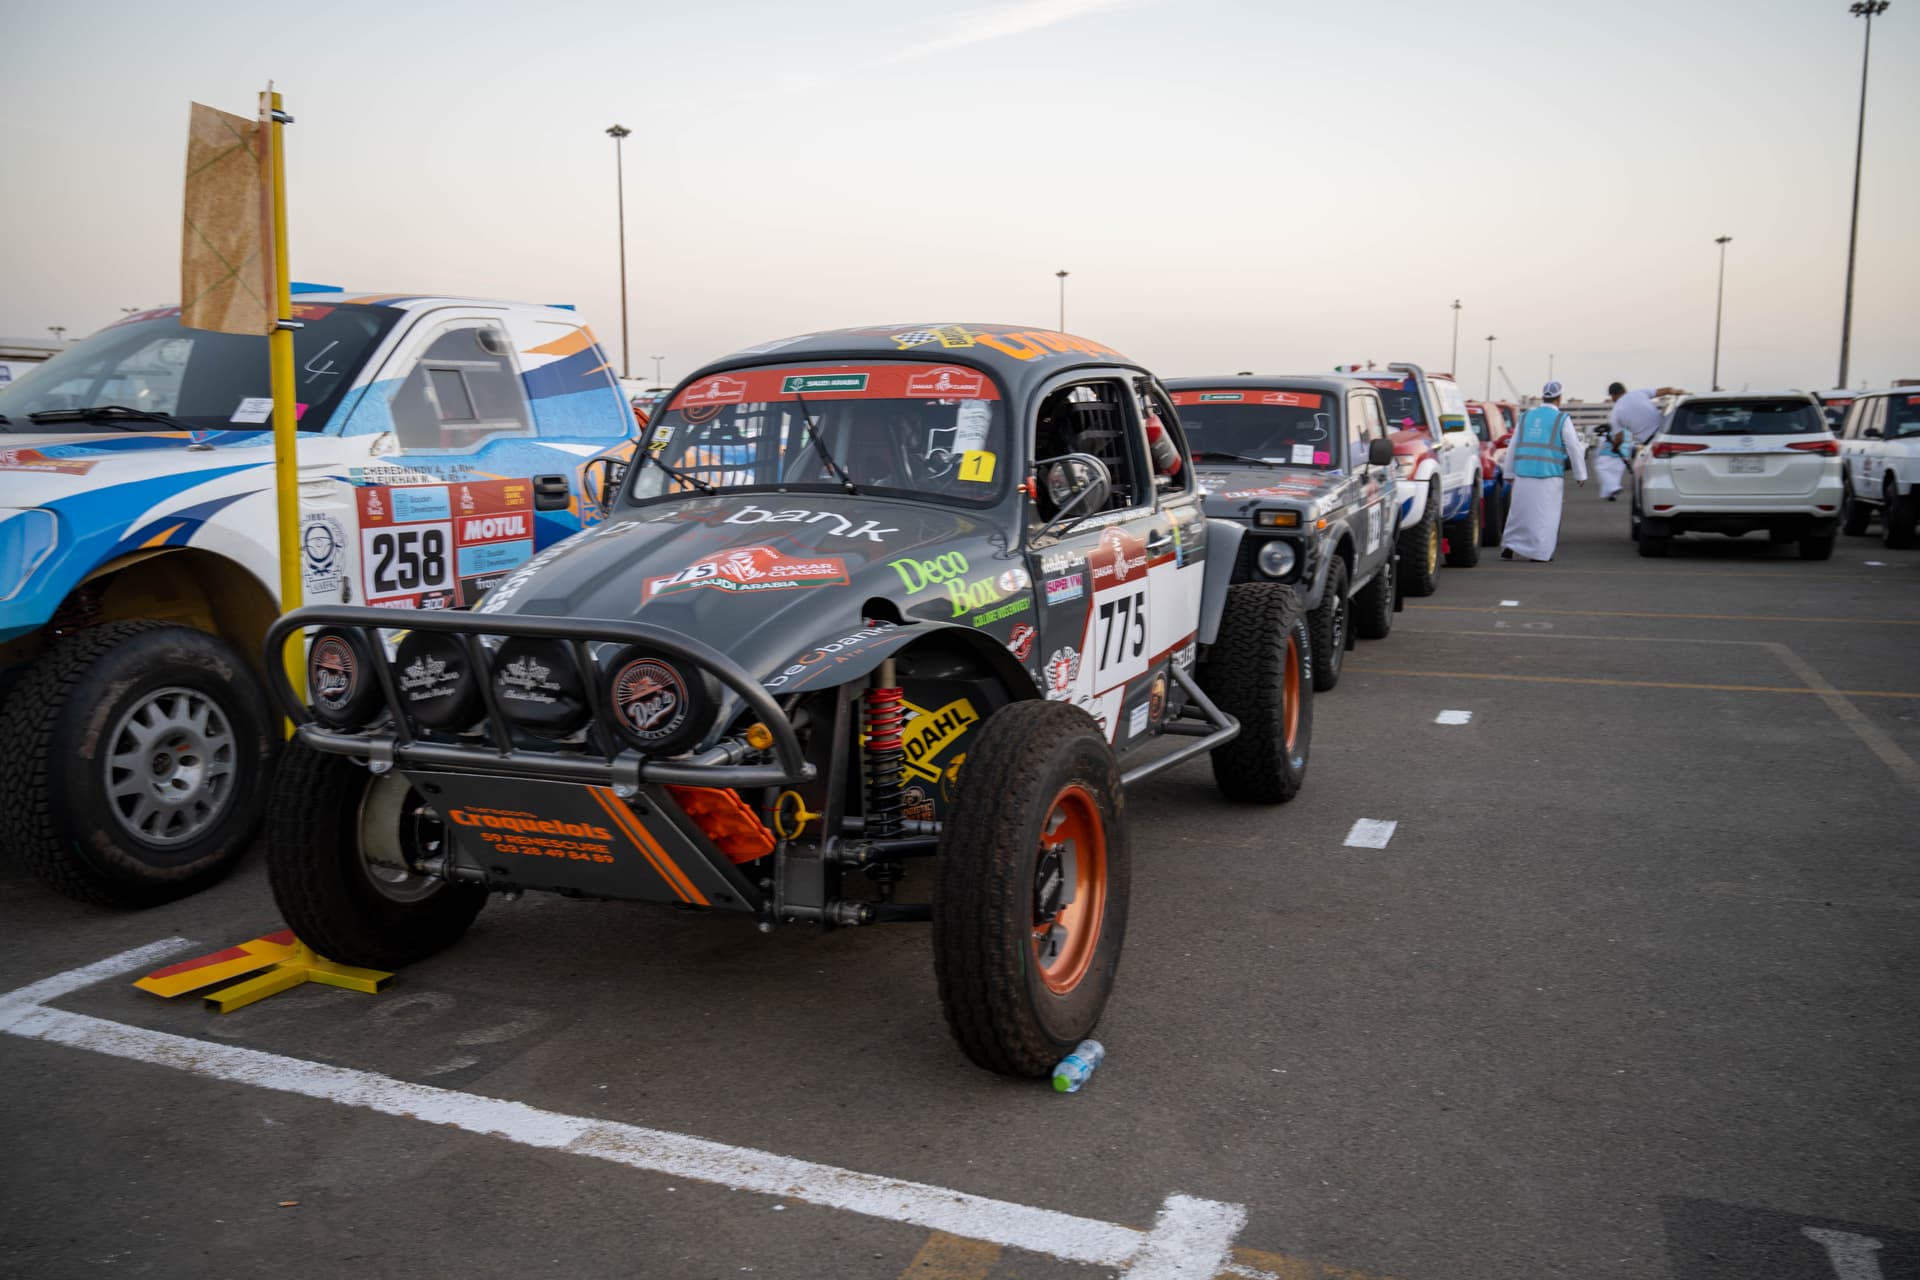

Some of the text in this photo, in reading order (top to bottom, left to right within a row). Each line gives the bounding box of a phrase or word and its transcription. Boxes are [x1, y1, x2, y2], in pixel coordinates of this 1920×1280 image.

[304, 339, 340, 384] 4
[1307, 412, 1331, 442] 5
[971, 455, 984, 476] 1
[463, 515, 526, 542] MOTUL
[373, 529, 445, 593] 258
[767, 567, 840, 578] CLASSIC
[773, 562, 833, 572] DAKAR
[887, 551, 969, 595] Deco
[1093, 564, 1113, 579] DAKAR
[690, 577, 799, 591] SAUDI ARABIA
[943, 575, 1001, 618] Box
[1046, 577, 1068, 593] SUPER
[1069, 574, 1083, 588] VW
[1099, 590, 1145, 672] 775
[905, 708, 971, 763] DAHL
[448, 808, 614, 841] Croquelois
[480, 831, 610, 855] 59 RENESCURE
[495, 843, 519, 854] 03
[521, 846, 542, 856] 28
